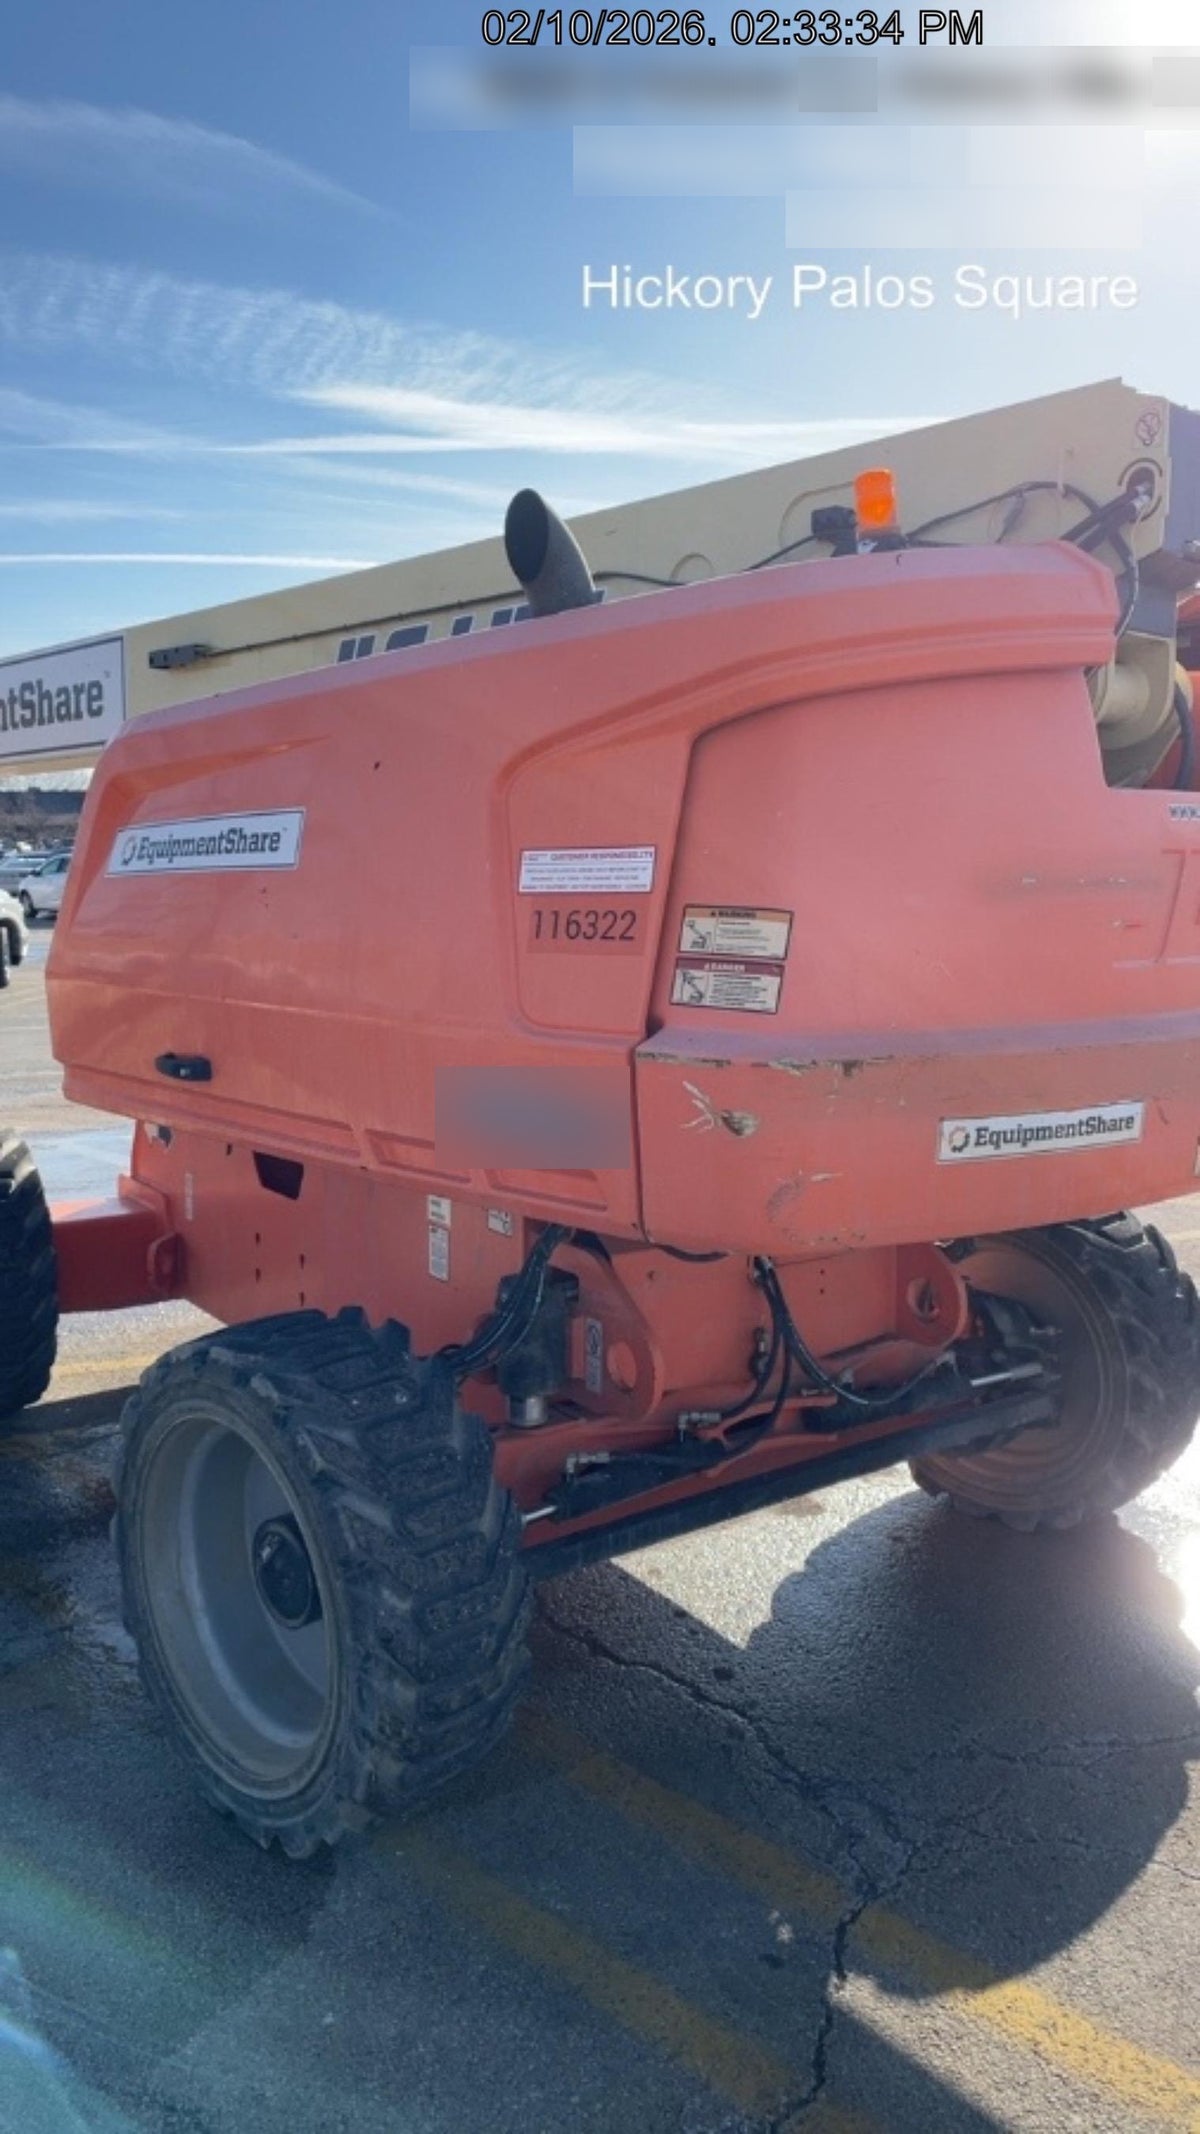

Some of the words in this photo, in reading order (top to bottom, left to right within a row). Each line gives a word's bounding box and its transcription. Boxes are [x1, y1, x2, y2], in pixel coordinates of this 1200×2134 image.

[137, 827, 281, 864] EquipmentShare
[534, 910, 636, 939] 116322
[974, 1115, 1135, 1149] EquipmentShare
